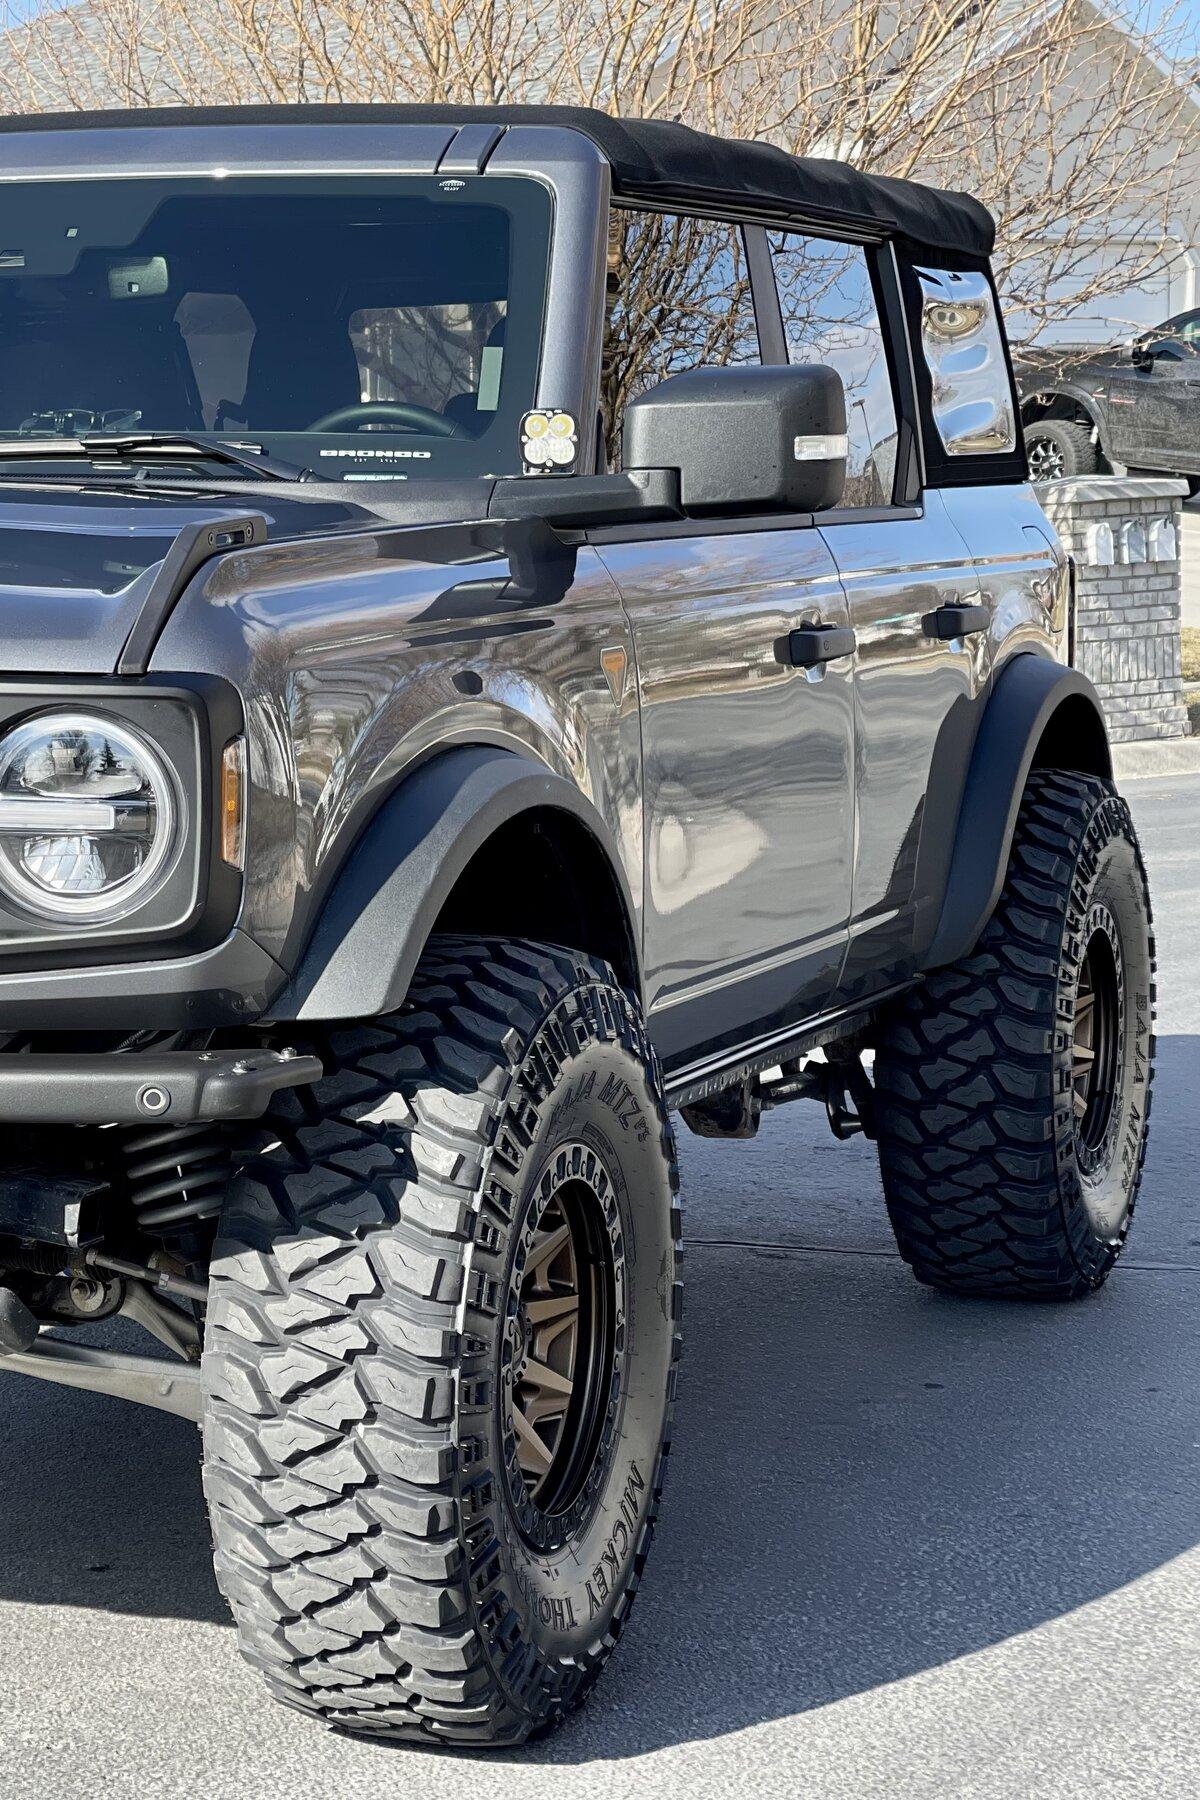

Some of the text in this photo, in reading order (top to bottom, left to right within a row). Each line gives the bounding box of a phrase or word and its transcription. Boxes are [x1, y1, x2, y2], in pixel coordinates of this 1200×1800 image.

[320, 450, 431, 458] BRONCO
[598, 1071, 642, 1130] MTZ
[585, 1460, 645, 1621] MICKEY
